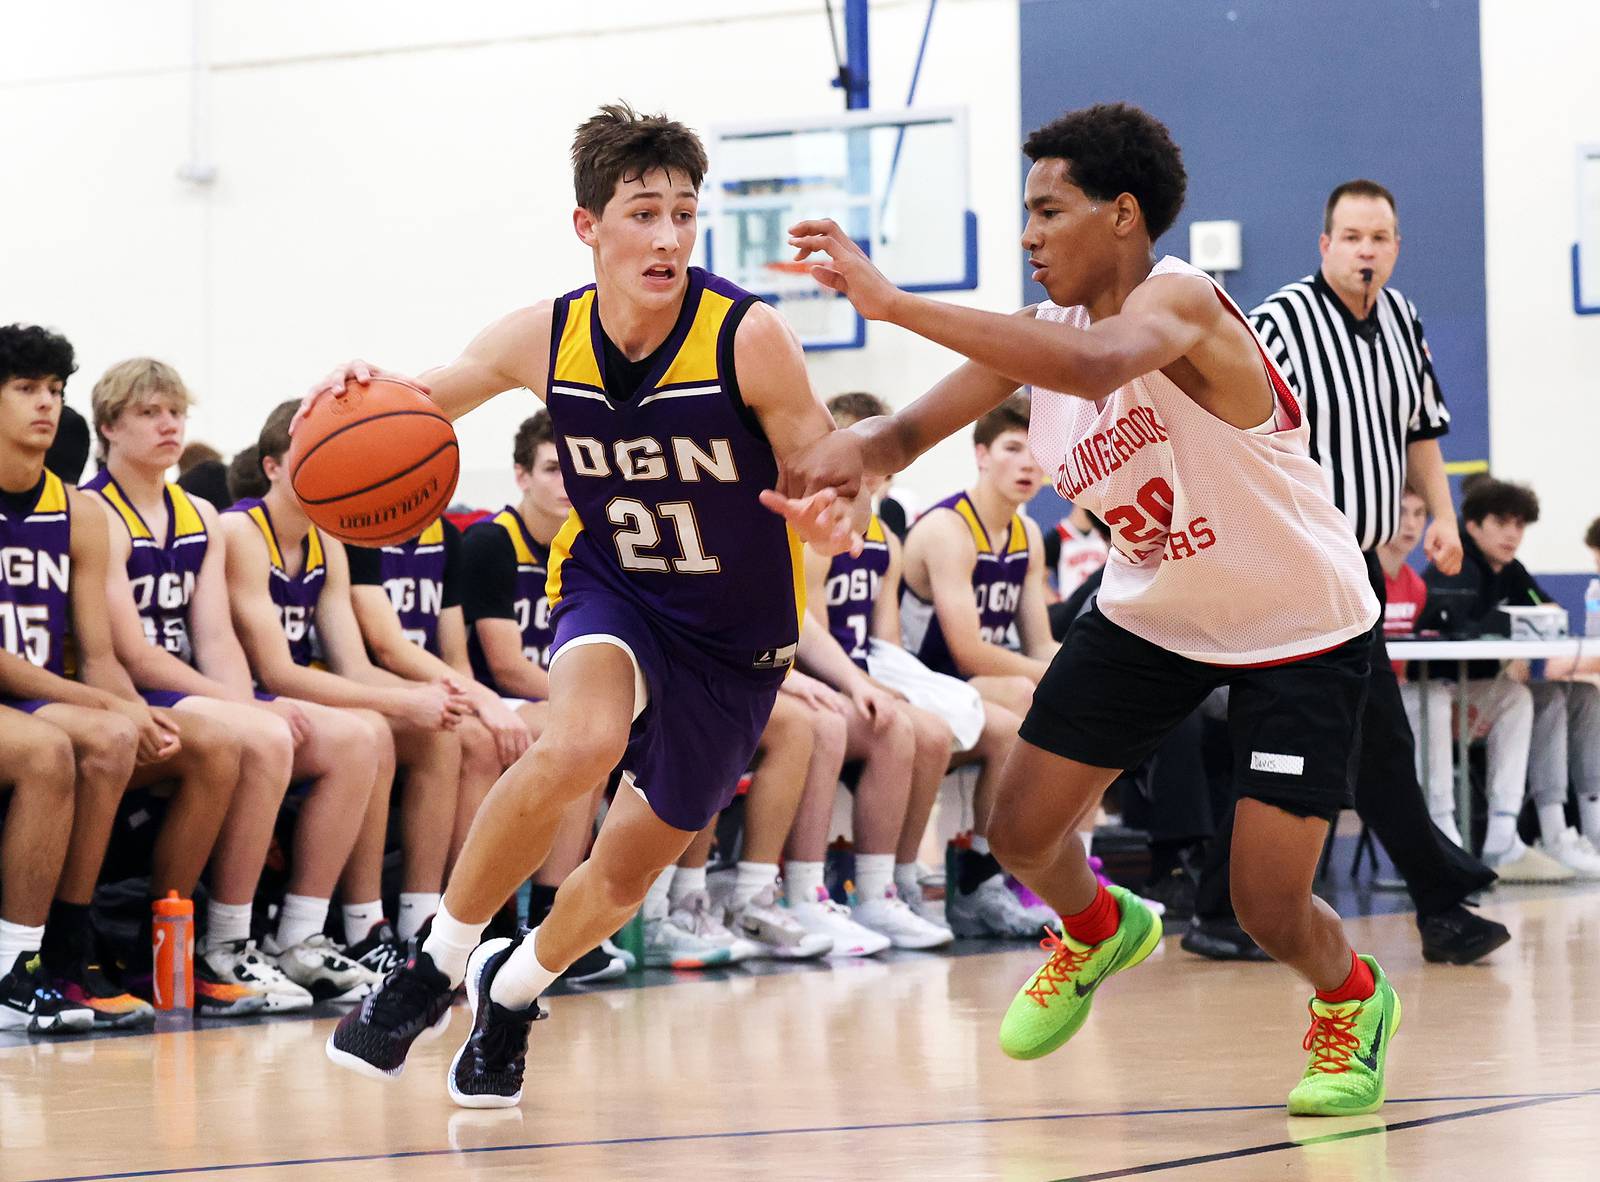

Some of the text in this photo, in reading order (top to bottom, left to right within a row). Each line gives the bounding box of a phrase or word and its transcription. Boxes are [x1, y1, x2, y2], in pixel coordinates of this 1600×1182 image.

[564, 435, 740, 483] DGN
[1104, 477, 1174, 544] 20
[606, 496, 721, 574] 21
[0, 546, 70, 594] GN
[0, 601, 51, 668] 15
[514, 595, 551, 633] DG
[846, 615, 869, 659] 1
